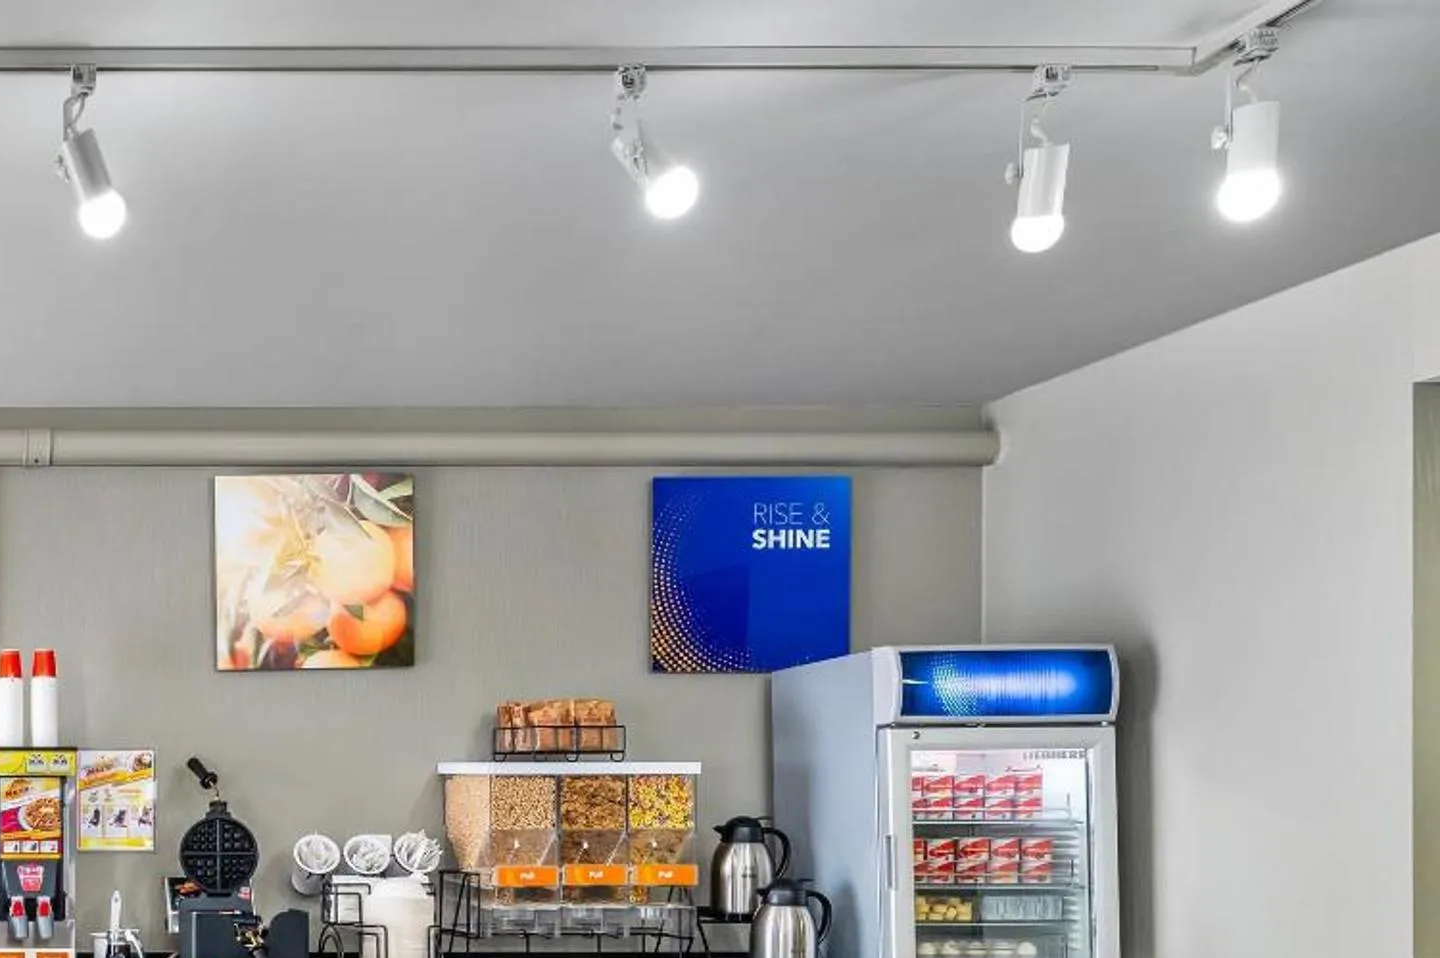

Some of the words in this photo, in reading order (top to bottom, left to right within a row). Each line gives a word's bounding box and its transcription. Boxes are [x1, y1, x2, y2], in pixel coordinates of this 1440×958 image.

[753, 502, 803, 525] RISE
[811, 502, 831, 525] &
[752, 528, 831, 550] SHINE
